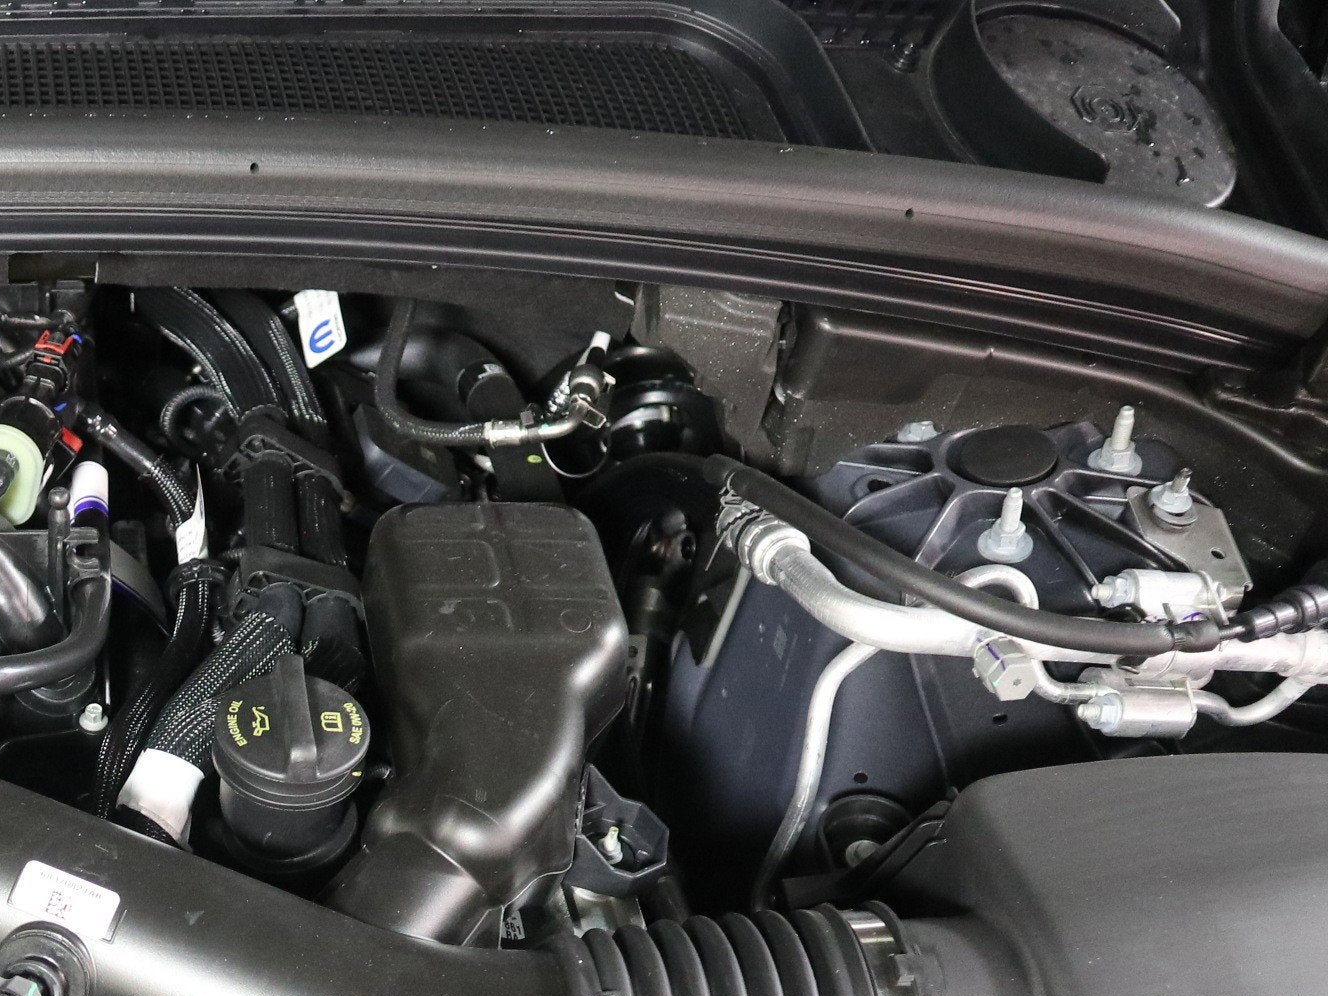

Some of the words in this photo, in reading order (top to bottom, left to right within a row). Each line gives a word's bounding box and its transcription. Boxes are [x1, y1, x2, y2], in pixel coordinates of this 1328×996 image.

[228, 700, 243, 713] OIL
[227, 714, 248, 747] ENGINE
[349, 726, 363, 745] SAE
